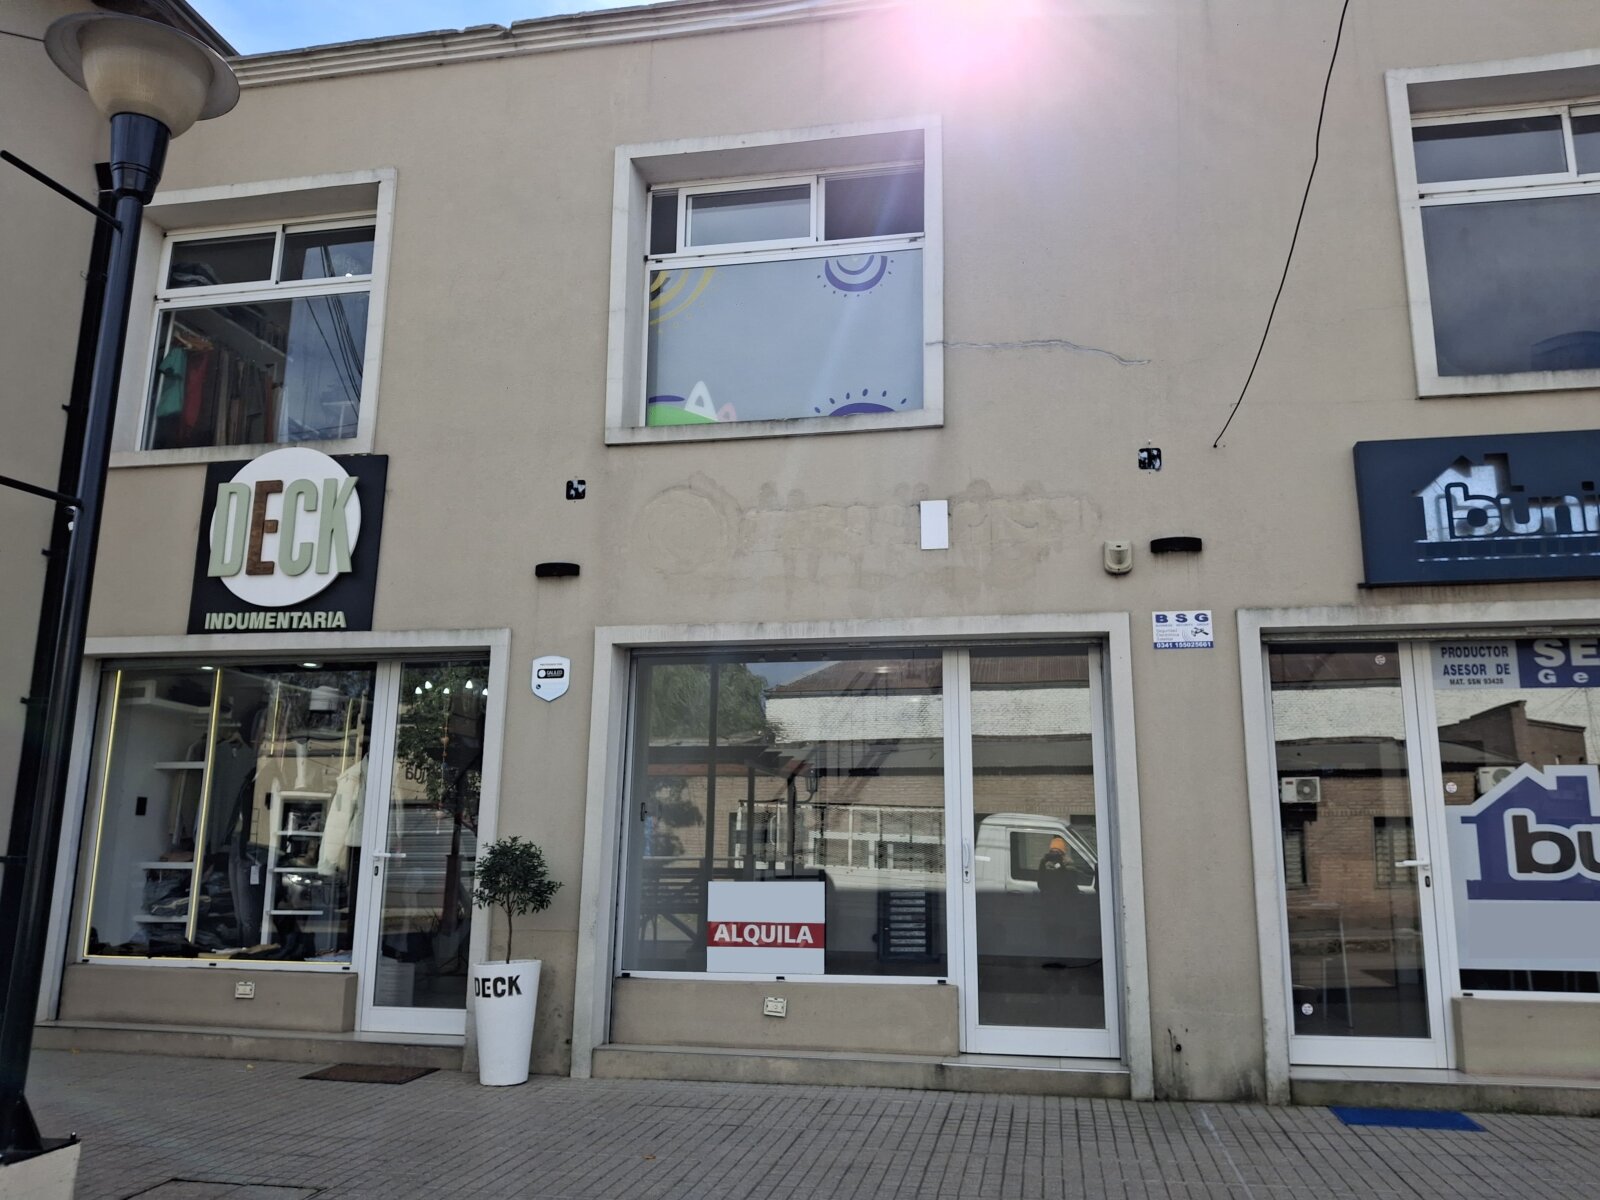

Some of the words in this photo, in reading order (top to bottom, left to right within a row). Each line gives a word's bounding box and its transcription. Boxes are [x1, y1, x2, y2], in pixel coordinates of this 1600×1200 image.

[207, 475, 359, 578] DECK
[204, 610, 347, 630] INDUMENTARIA
[1440, 645, 1509, 659] PRODUCTOR
[1443, 663, 1487, 676] ASESOR
[1495, 663, 1511, 675] DE
[713, 923, 814, 946] ALQUILA
[474, 974, 523, 999] DECK
